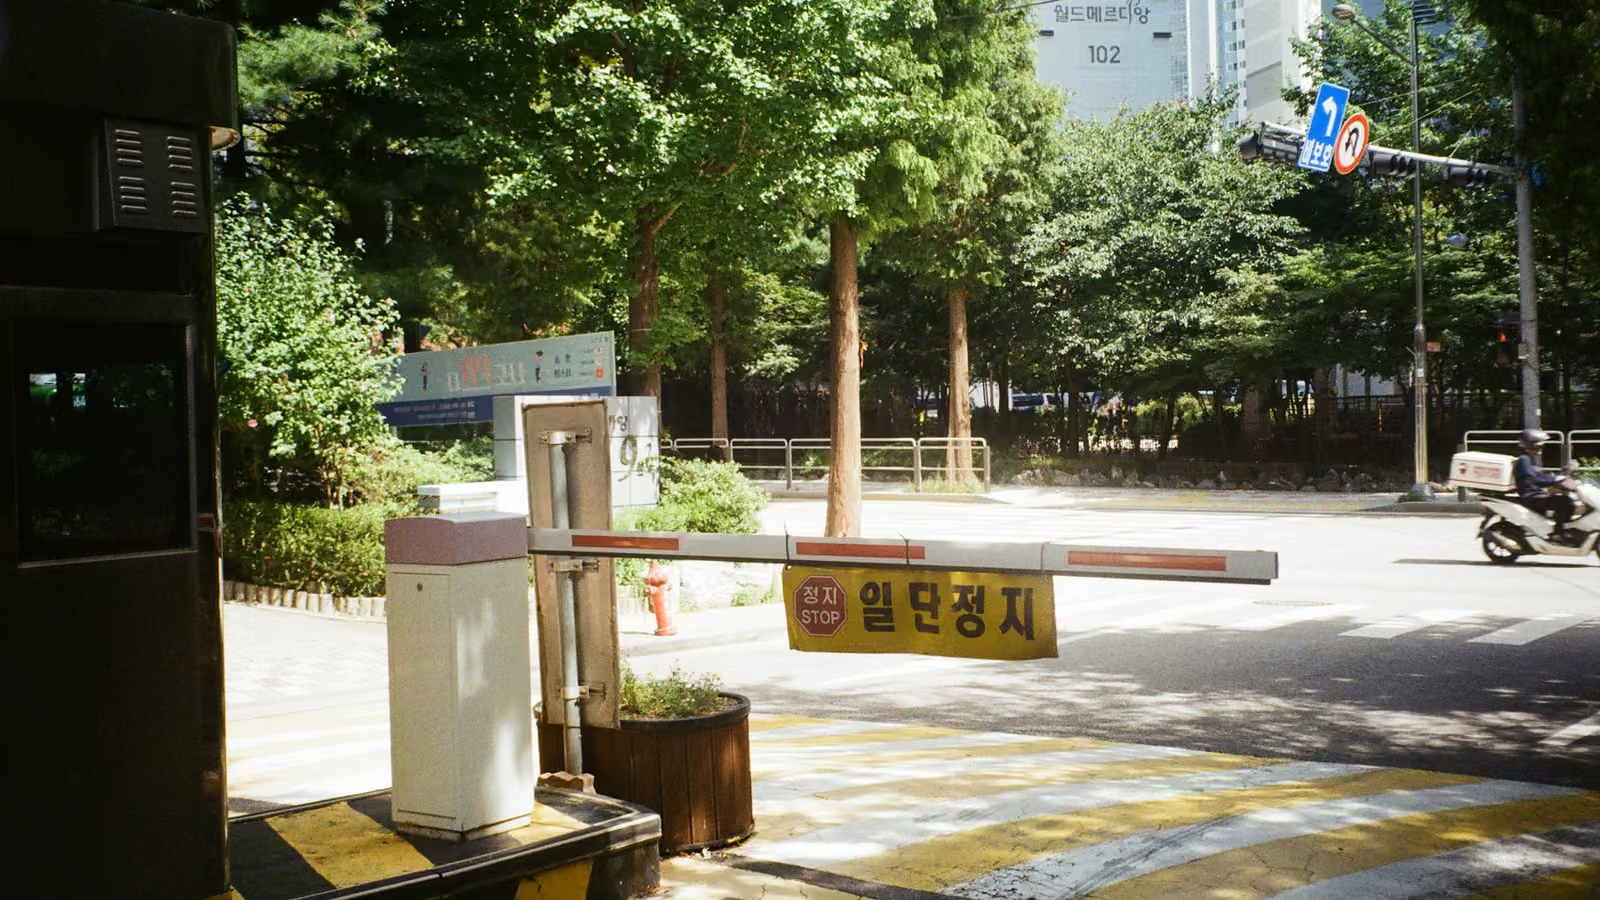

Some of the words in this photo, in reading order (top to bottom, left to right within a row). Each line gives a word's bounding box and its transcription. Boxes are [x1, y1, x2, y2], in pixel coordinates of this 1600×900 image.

[1054, 5, 1151, 24] 월드메르디앙
[1088, 45, 1121, 63] 102
[803, 586, 837, 605] 정지
[801, 609, 840, 625] STOP
[859, 581, 1035, 641] 일단정지
